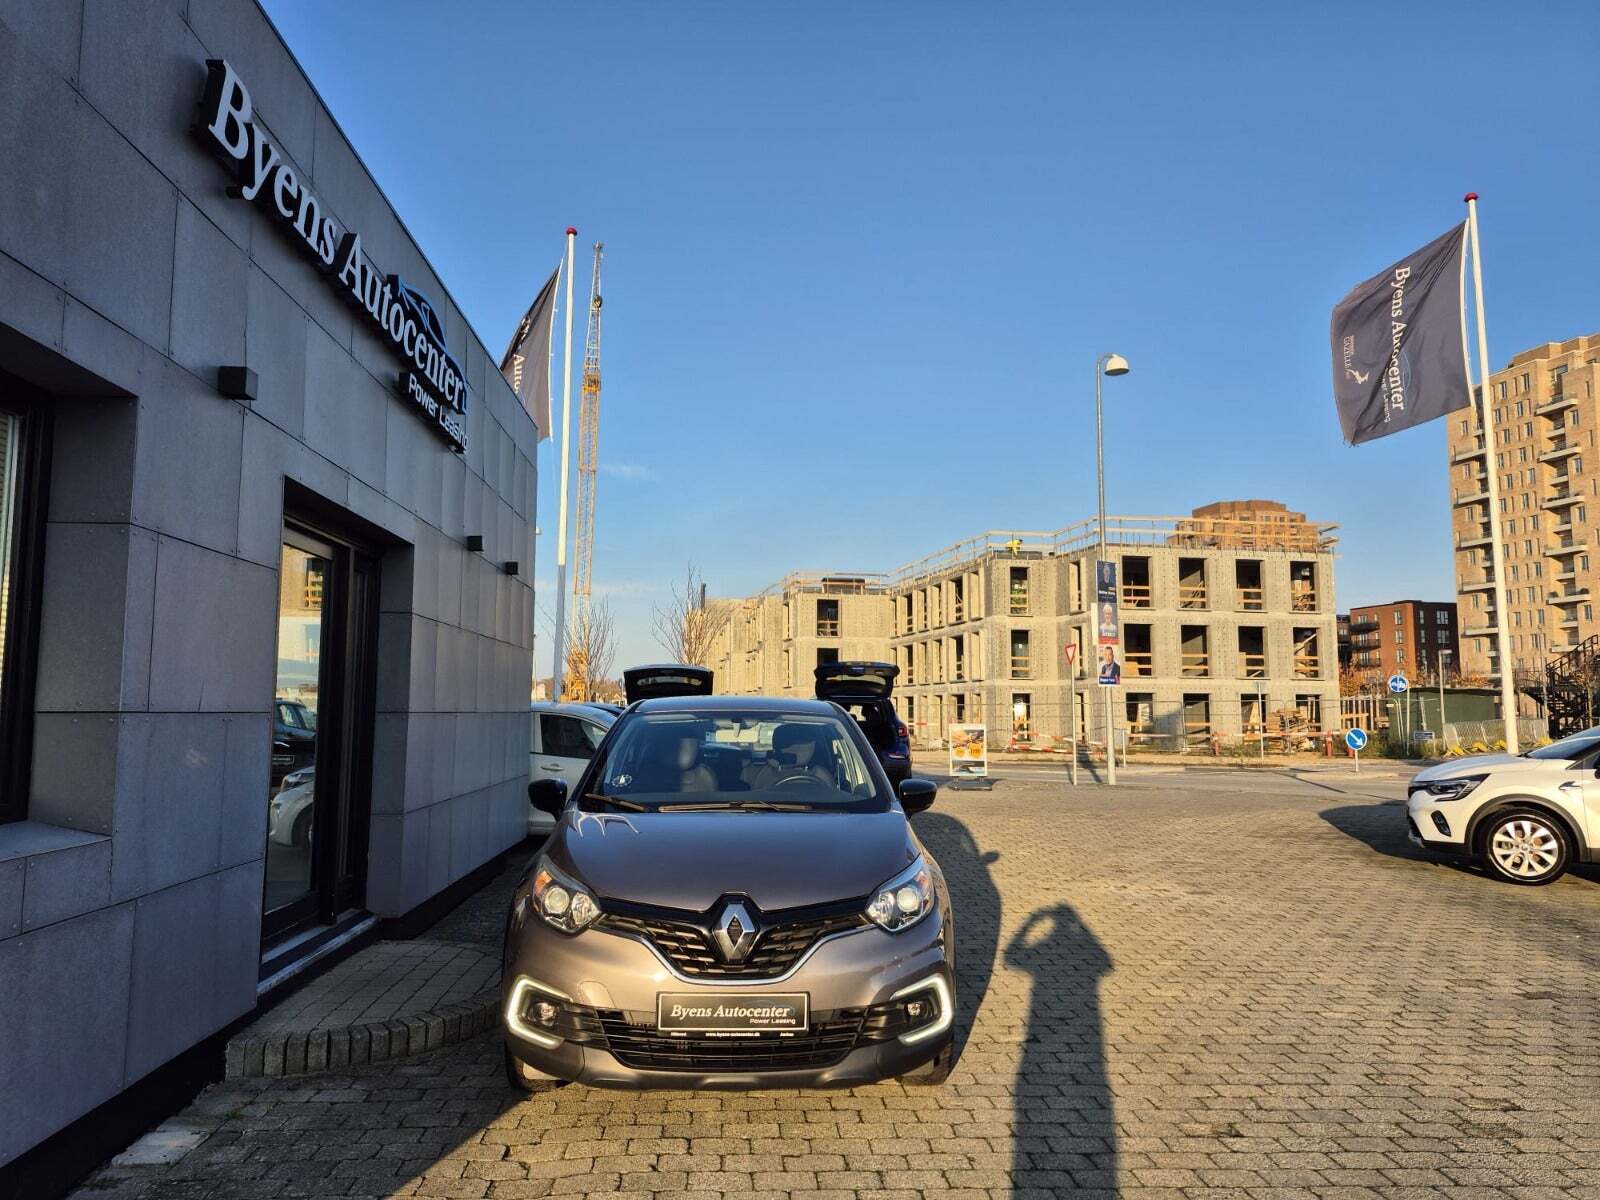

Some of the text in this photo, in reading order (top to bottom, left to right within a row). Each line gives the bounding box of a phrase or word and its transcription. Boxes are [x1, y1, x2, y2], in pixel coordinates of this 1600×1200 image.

[208, 59, 463, 410] Byens Autocenter
[1391, 266, 1411, 318] Byens
[408, 372, 469, 454] Power Leasing
[670, 1004, 790, 1021] Byens Autocenter
[771, 1018, 796, 1026] Leasing
